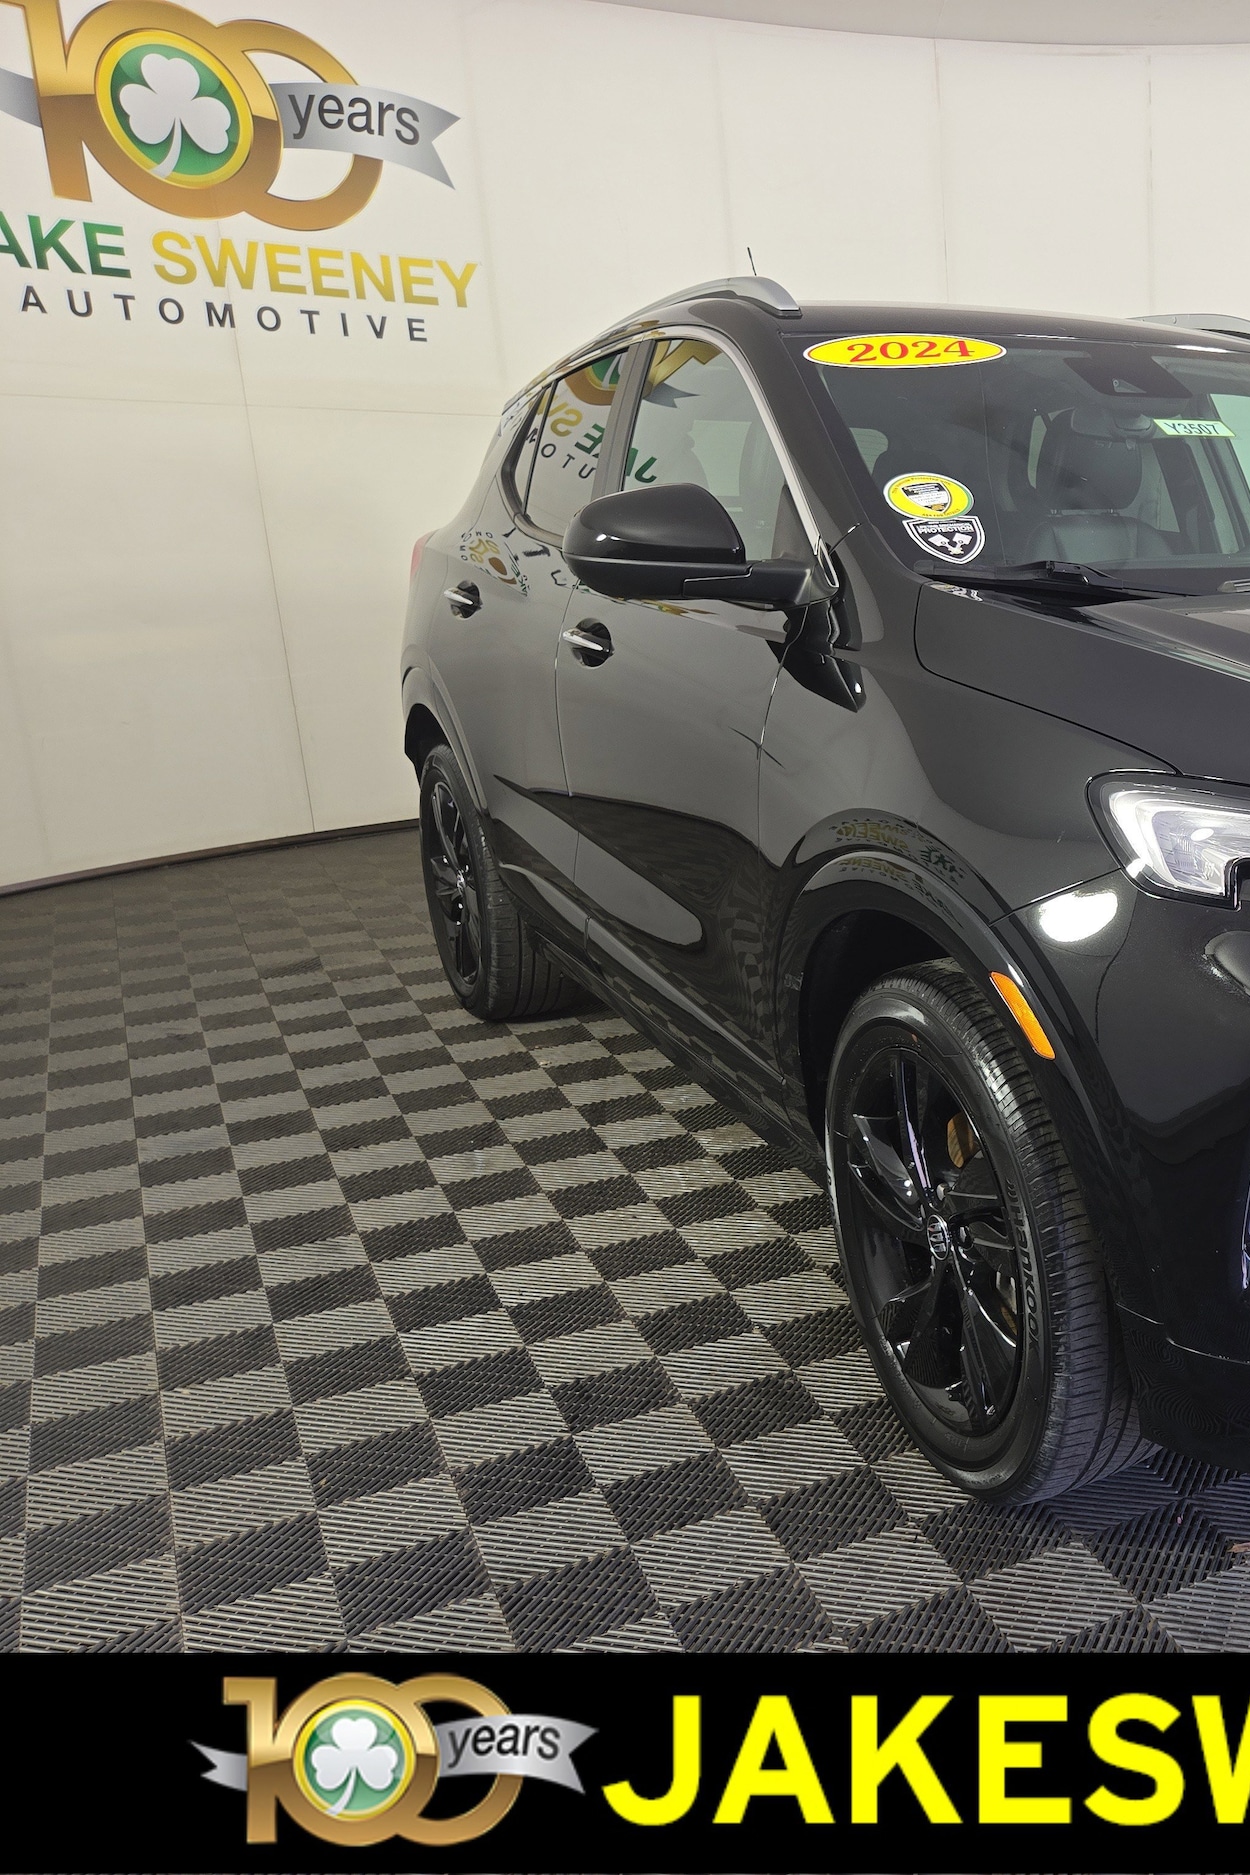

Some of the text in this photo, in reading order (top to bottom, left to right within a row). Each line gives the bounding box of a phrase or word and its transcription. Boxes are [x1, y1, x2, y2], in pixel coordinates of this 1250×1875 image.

[287, 86, 421, 146] years
[0, 209, 479, 308] AKE SWEENEY
[20, 284, 429, 344] AUTOMOTIVE
[846, 340, 976, 363] 2024
[1163, 421, 1220, 435] Y3507
